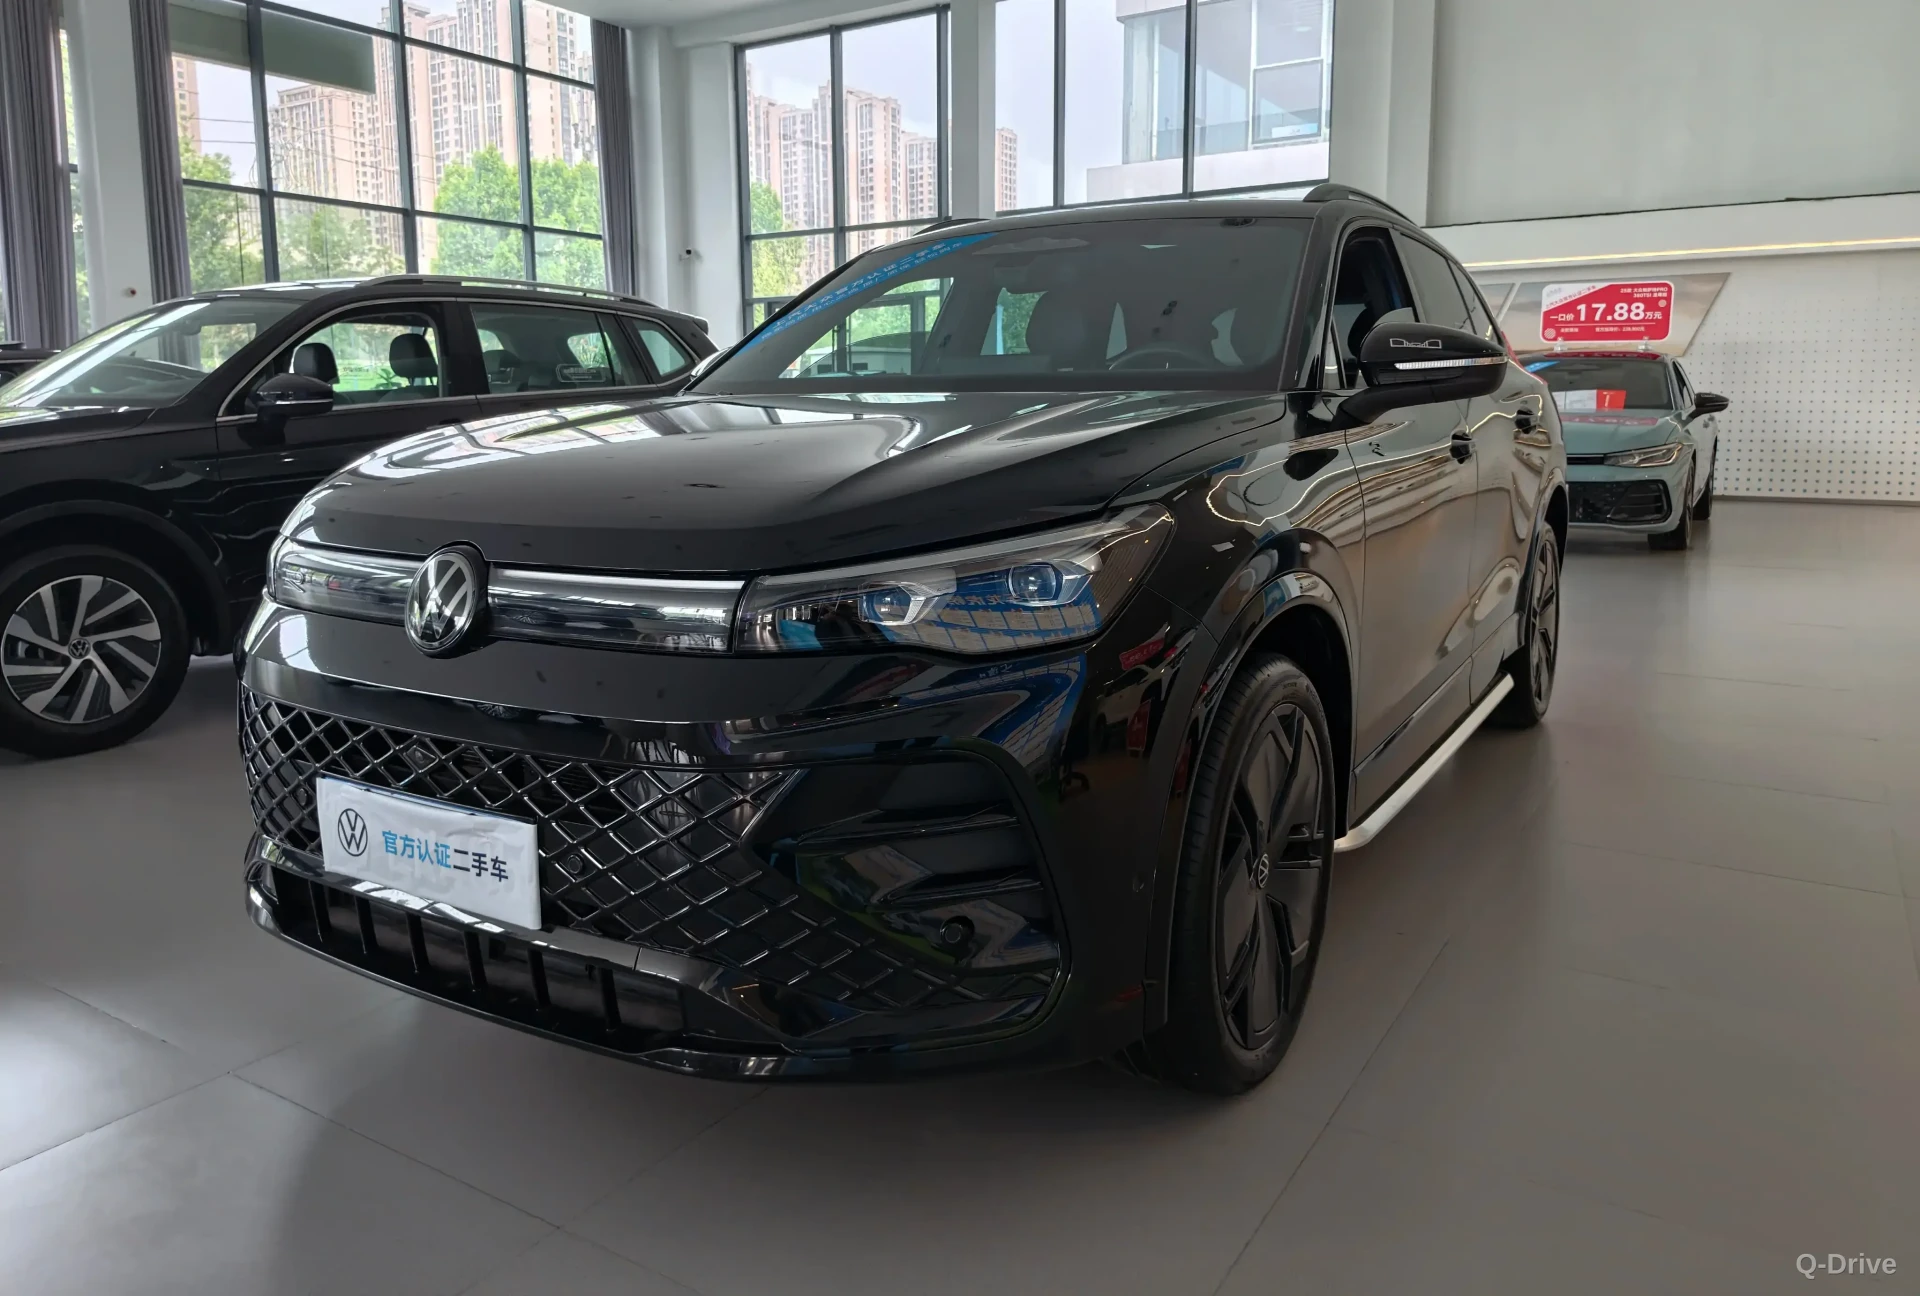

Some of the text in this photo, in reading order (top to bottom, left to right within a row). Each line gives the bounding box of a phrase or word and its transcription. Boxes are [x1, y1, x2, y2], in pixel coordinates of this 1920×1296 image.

[1550, 302, 1662, 321] 一口价 17.88 万元
[338, 808, 368, 857] VW
[382, 830, 508, 882] 官方认证二手车
